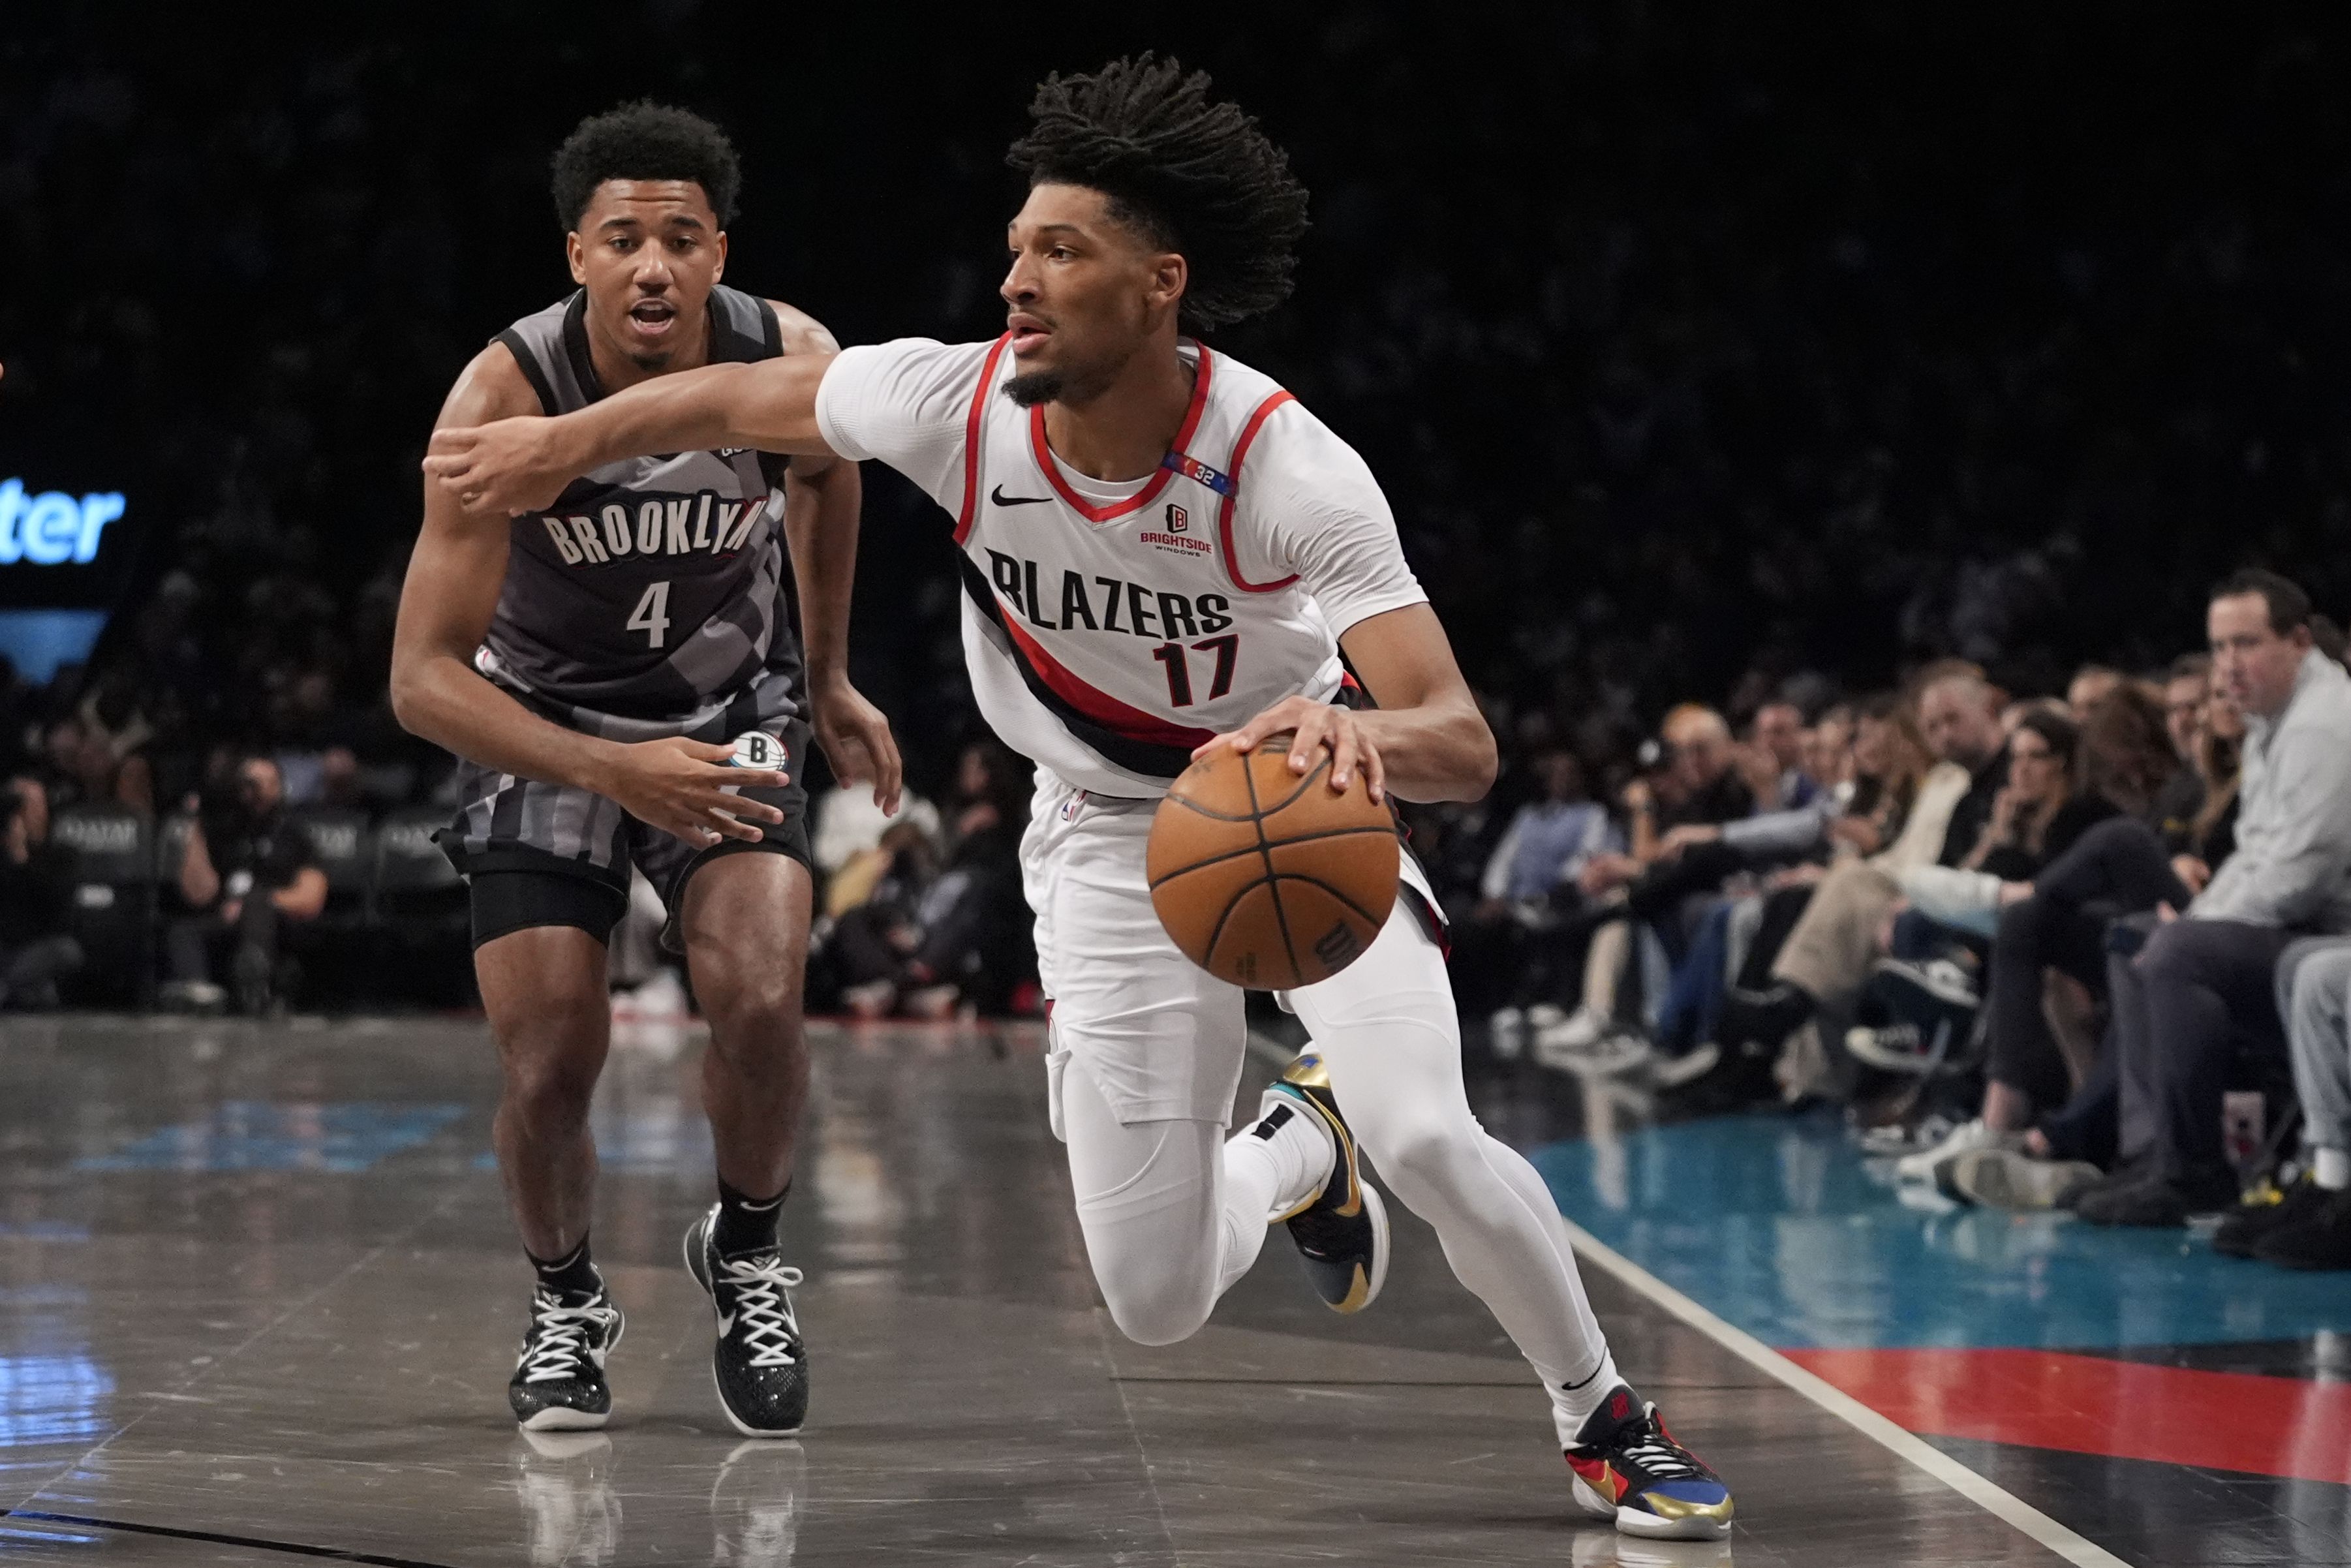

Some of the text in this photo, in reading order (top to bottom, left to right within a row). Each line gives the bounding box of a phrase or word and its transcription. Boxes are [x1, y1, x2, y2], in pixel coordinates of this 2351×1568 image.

[1195, 465, 1215, 485] 32
[1175, 510, 1184, 527] B
[1141, 532, 1212, 554] BRIGHTSIDE
[1155, 545, 1201, 557] WINDOWS
[984, 547, 1233, 640] BLAZERS
[626, 581, 670, 648] 4
[1152, 634, 1238, 707] 17
[750, 737, 767, 763] B
